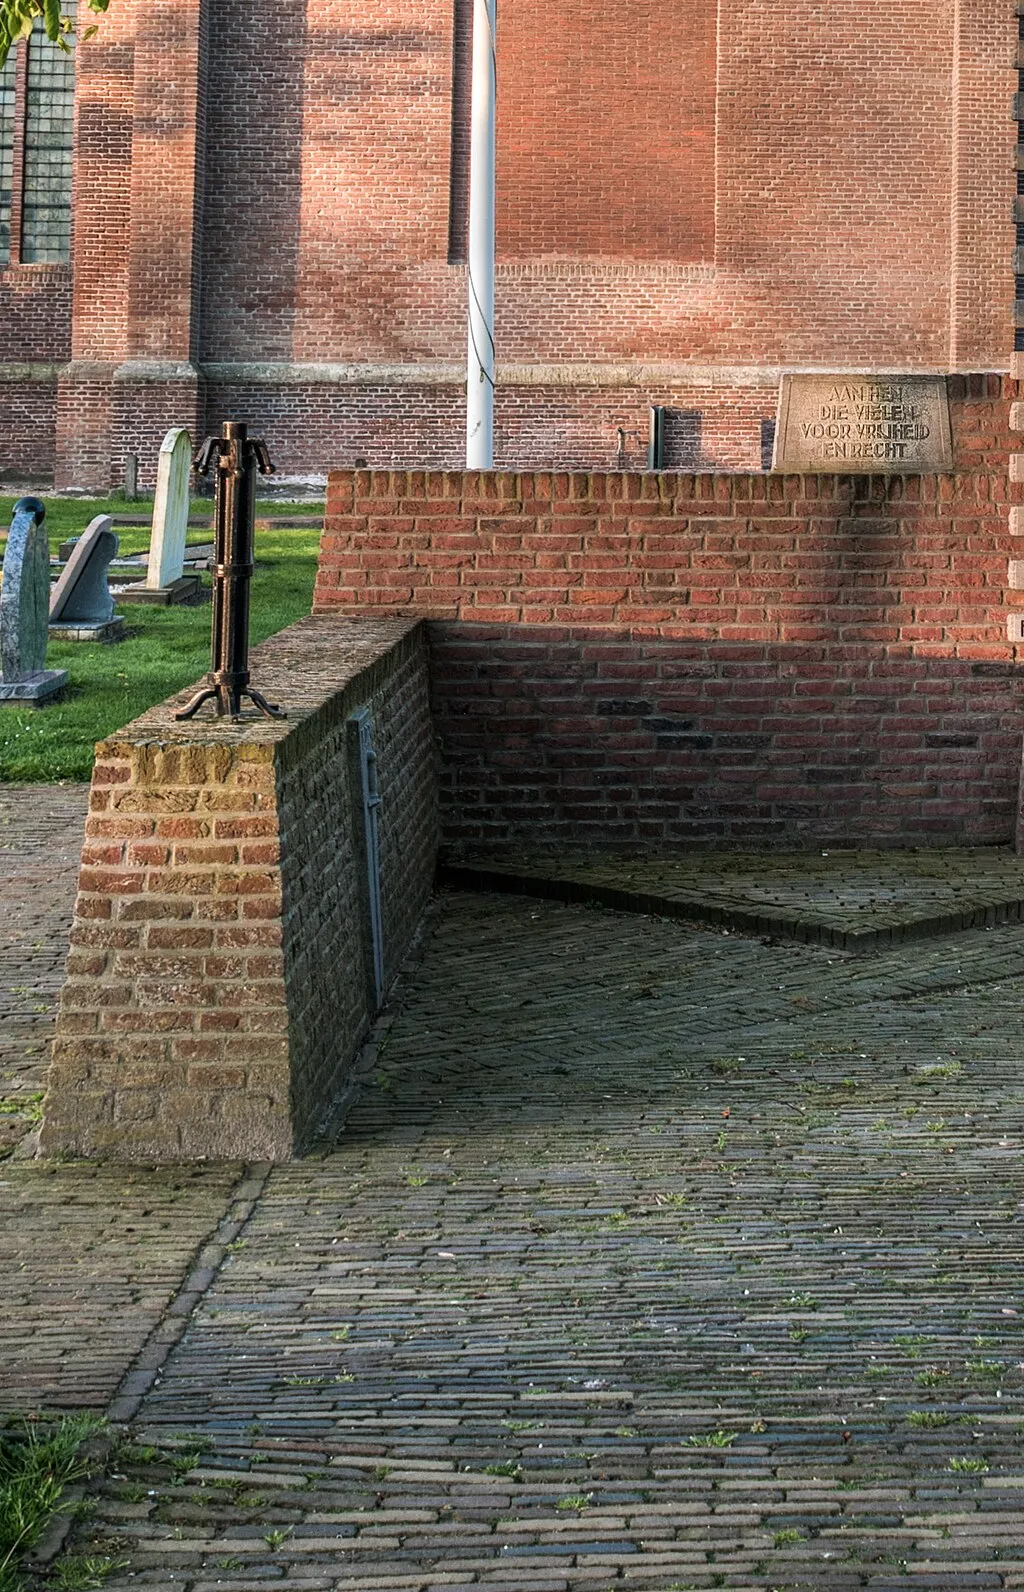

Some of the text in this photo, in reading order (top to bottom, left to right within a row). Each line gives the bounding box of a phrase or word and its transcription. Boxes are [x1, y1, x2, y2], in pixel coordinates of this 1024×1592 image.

[829, 386, 903, 403] AAN HEN
[820, 405, 919, 421] DIE VIELEN
[801, 423, 931, 440] VOOR VRIJHEID
[824, 442, 908, 458] EN RECHT
